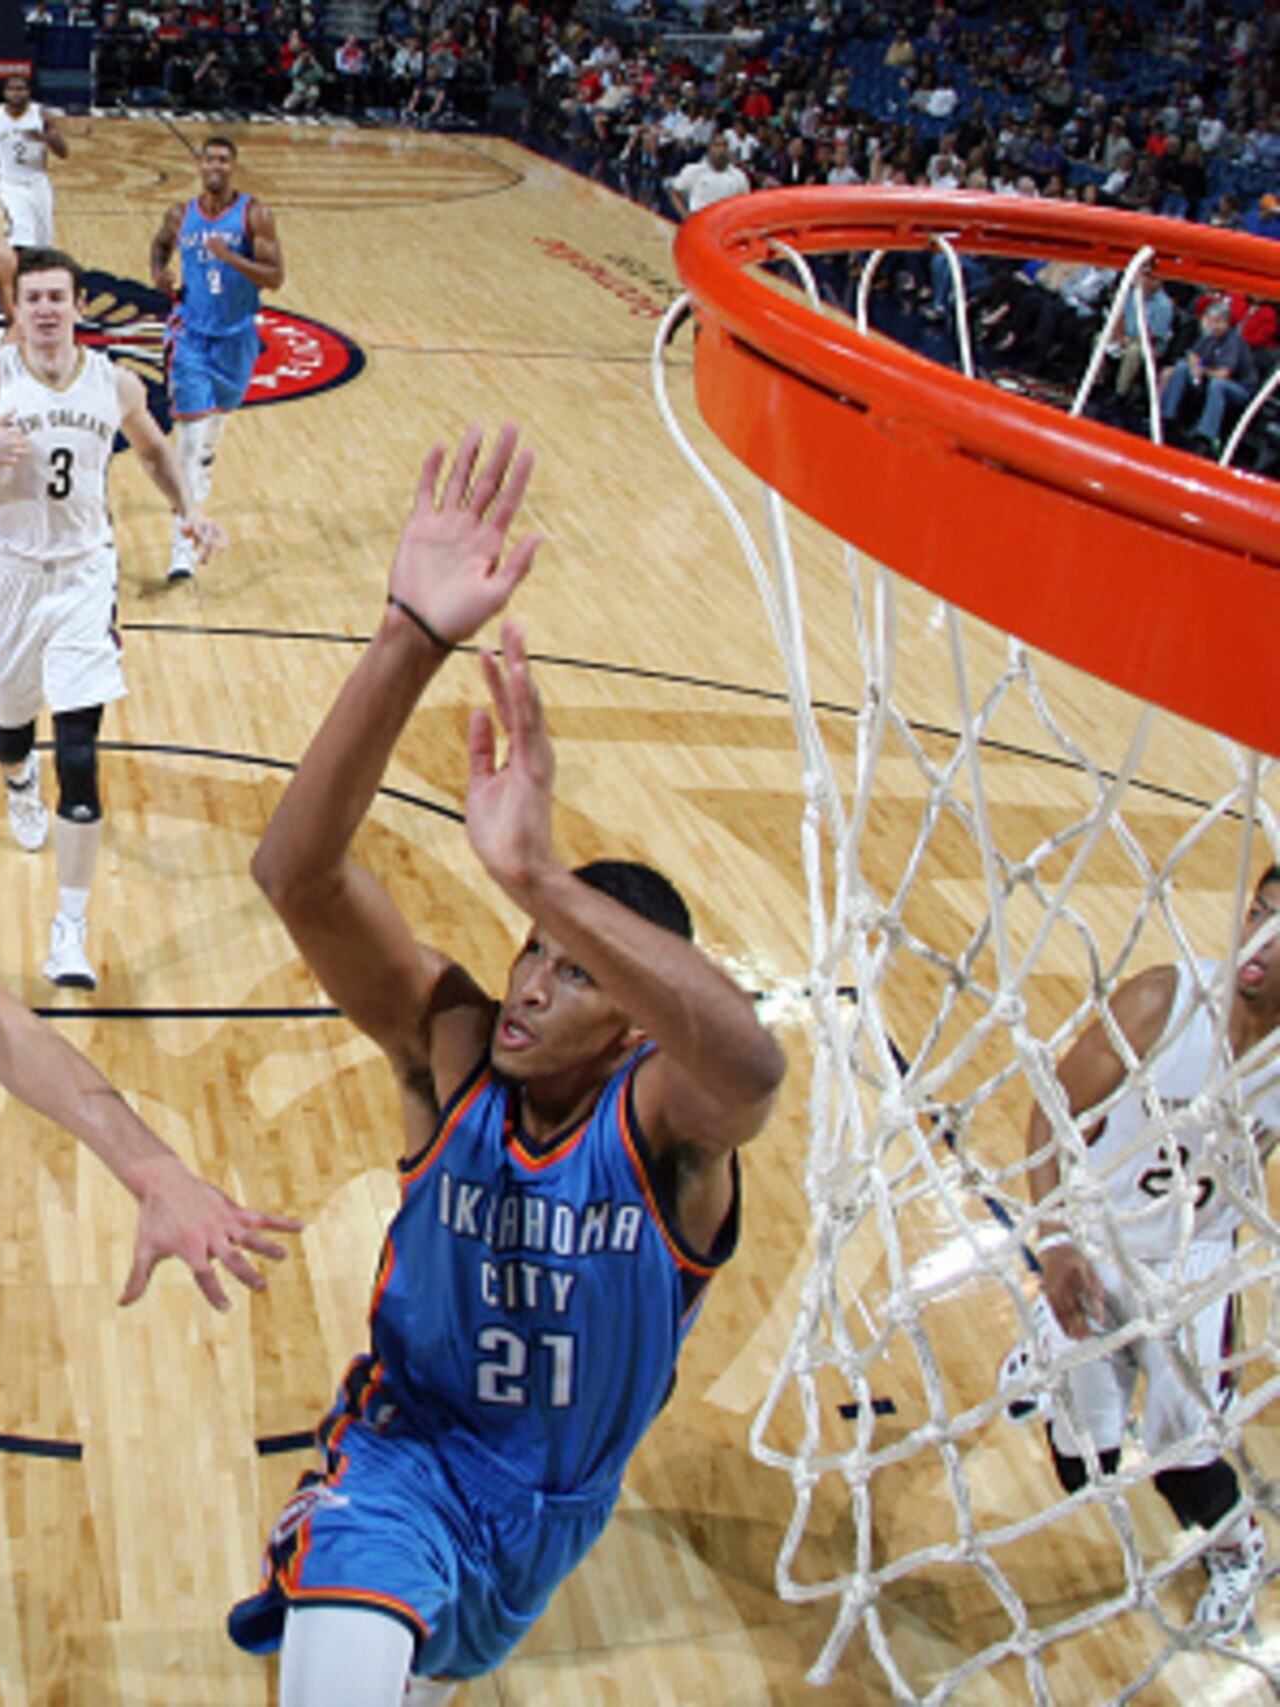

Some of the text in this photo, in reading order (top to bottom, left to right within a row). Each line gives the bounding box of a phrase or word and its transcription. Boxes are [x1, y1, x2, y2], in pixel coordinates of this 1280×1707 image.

[47, 448, 74, 500] 3
[481, 1260, 574, 1313] CITY
[477, 1326, 574, 1407] 21
